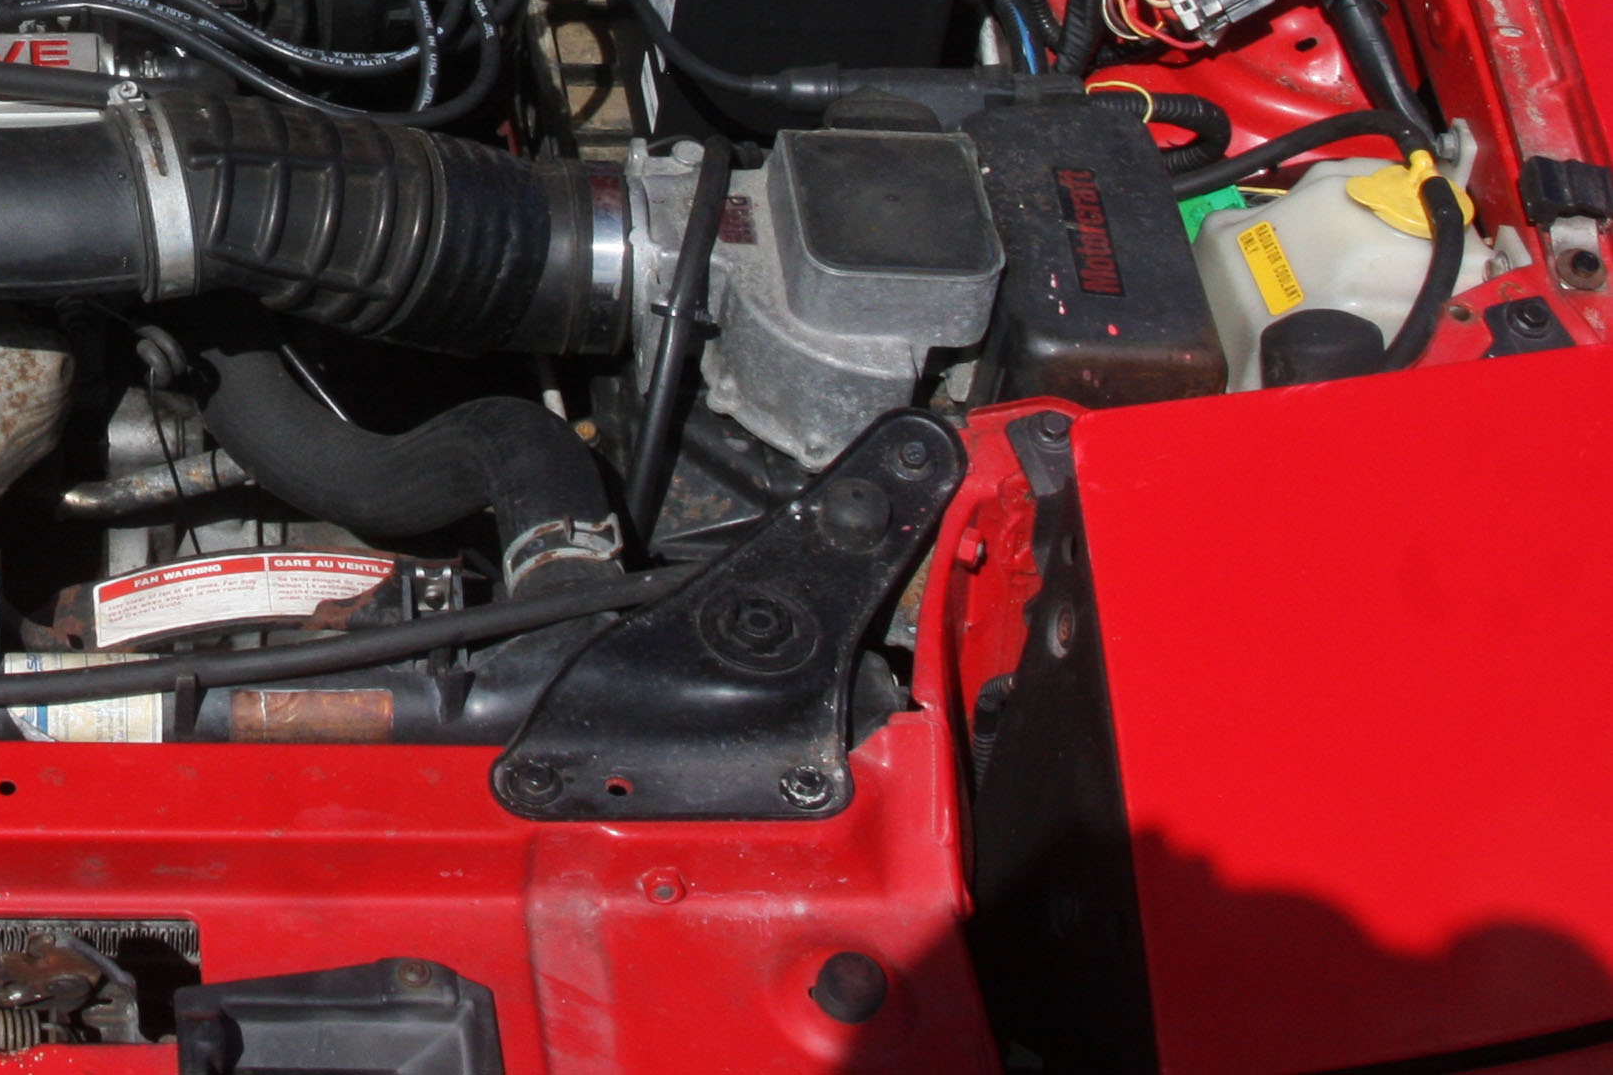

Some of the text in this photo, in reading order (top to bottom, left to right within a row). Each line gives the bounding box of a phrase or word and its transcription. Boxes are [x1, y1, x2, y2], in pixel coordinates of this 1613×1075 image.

[155, 5, 192, 21] CABLE
[419, 0, 434, 29] MADE
[427, 35, 436, 46] IN
[353, 57, 386, 67] ULTRA
[427, 53, 437, 77] USA
[1057, 169, 1123, 293] Motorcraft
[1240, 232, 1259, 254] ONLY
[1255, 224, 1301, 302] RADIATOR COOLANT
[273, 559, 311, 567] GARE
[316, 560, 334, 568] AU
[134, 564, 222, 588] FAN WARNING
